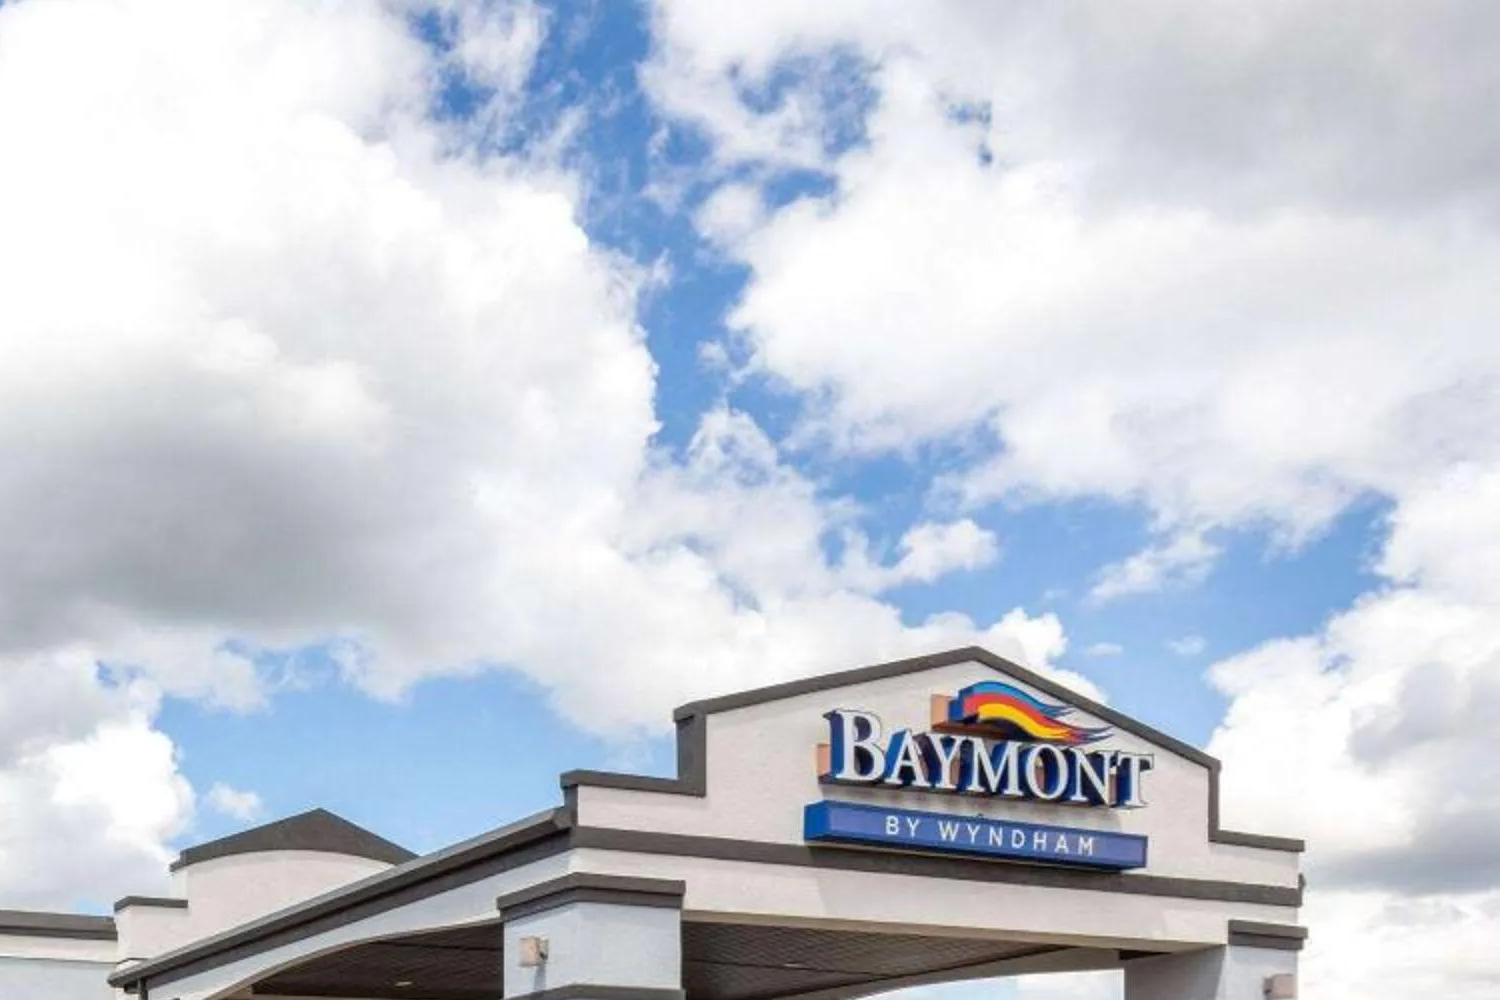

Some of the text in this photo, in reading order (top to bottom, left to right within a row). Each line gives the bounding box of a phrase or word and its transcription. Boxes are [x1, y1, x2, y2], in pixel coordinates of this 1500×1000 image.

[825, 708, 1154, 809] BAYMONT
[885, 815, 1094, 857] BY WYNDHAM
